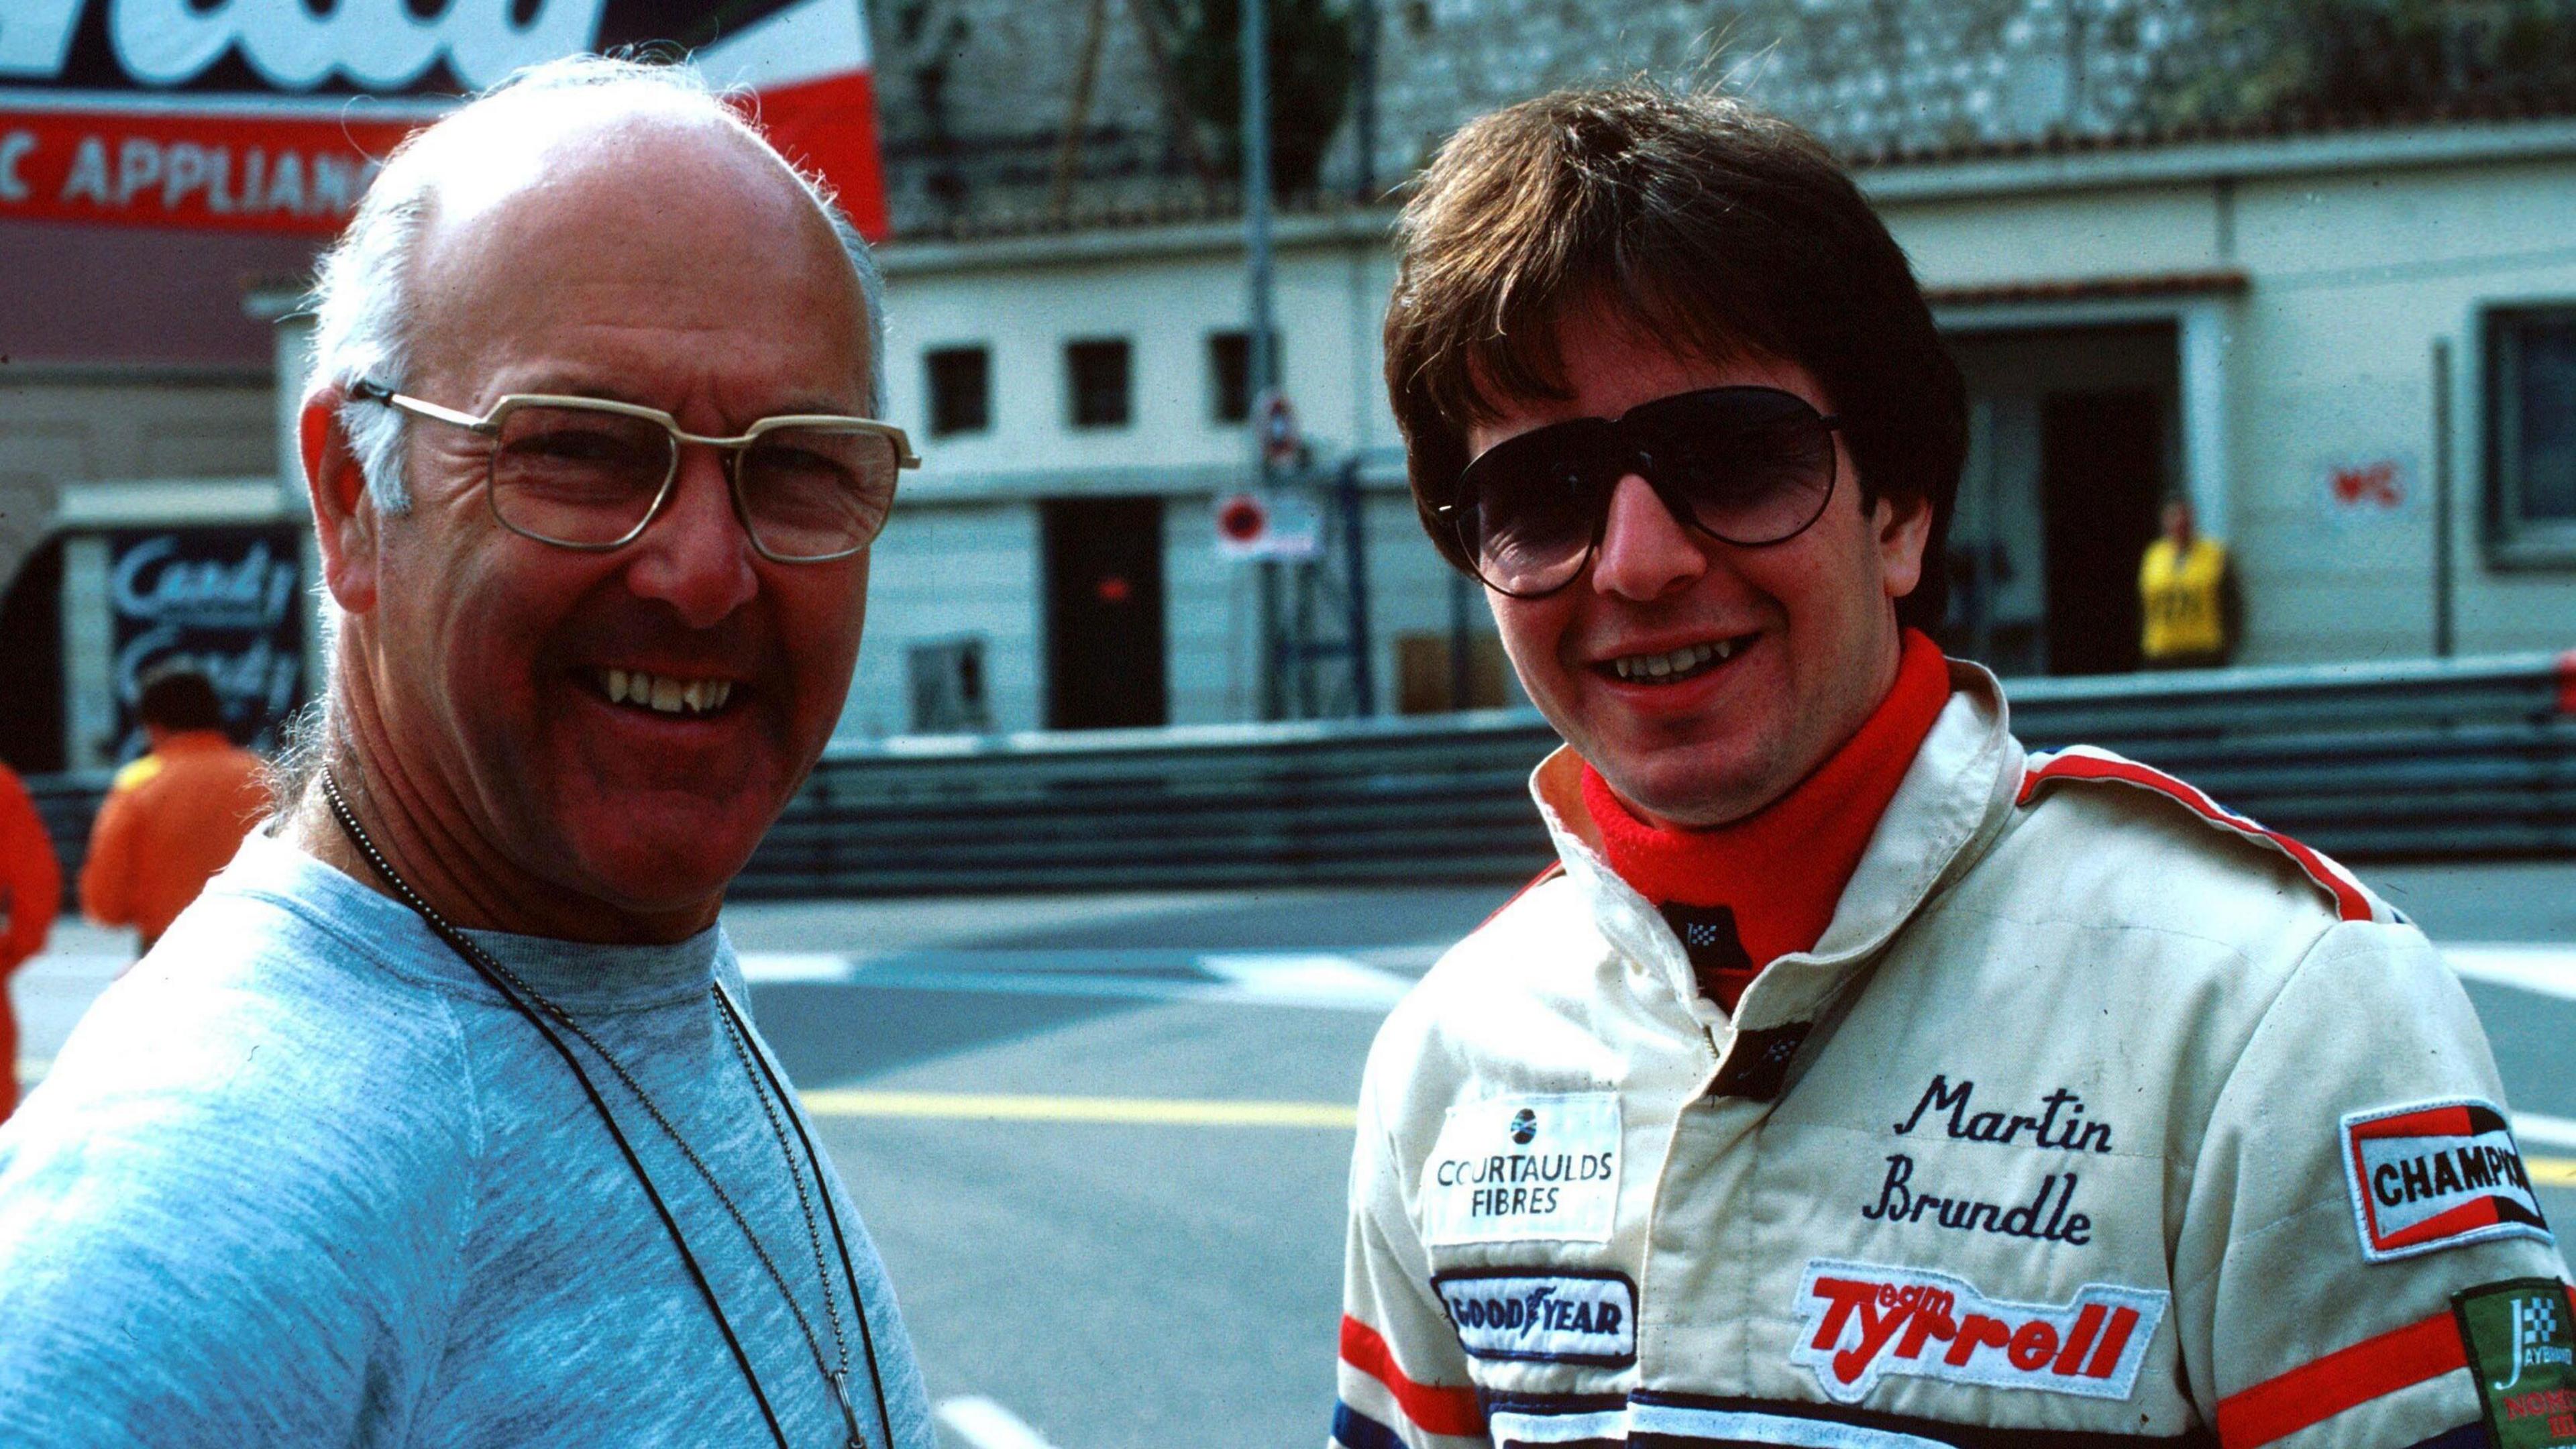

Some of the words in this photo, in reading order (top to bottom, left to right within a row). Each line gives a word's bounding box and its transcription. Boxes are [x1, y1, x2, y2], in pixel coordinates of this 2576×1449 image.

[1893, 1075, 2112, 1152] Martin
[1437, 1152, 1613, 1187] COURTAULDS
[1472, 1187, 1560, 1218] FIBRES
[1862, 1155, 2092, 1244] Brundle
[1452, 1285, 1623, 1340] GOODYEAR
[1811, 1277, 2141, 1385] Tyrrell
